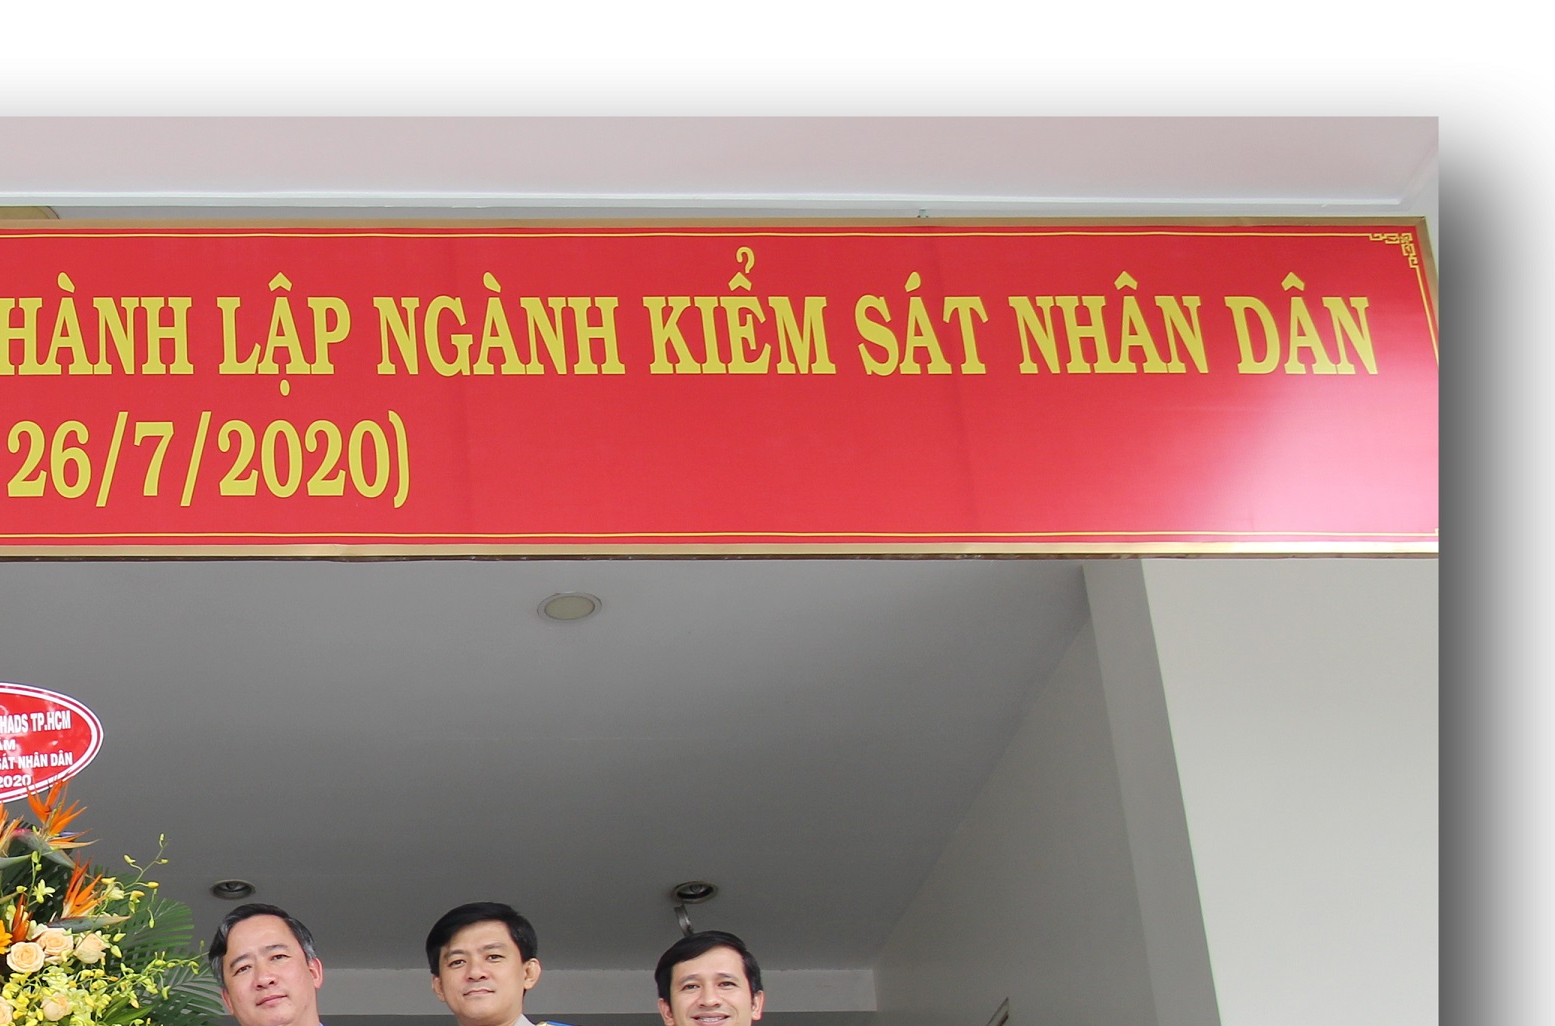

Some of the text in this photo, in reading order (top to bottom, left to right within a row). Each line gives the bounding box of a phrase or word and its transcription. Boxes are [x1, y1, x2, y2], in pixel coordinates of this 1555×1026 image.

[216, 272, 351, 396] LẬP
[373, 272, 626, 377] NGÀNH
[642, 246, 837, 375] KIỂM
[855, 272, 989, 376] SÁT
[1008, 271, 1209, 375] NHÂN
[1223, 271, 1379, 375] DÂN
[6, 410, 410, 508] 26/7/2020)
[30, 710, 72, 732] TP.HCM
[17, 752, 48, 769] NHÂN
[50, 750, 73, 767] DÂN
